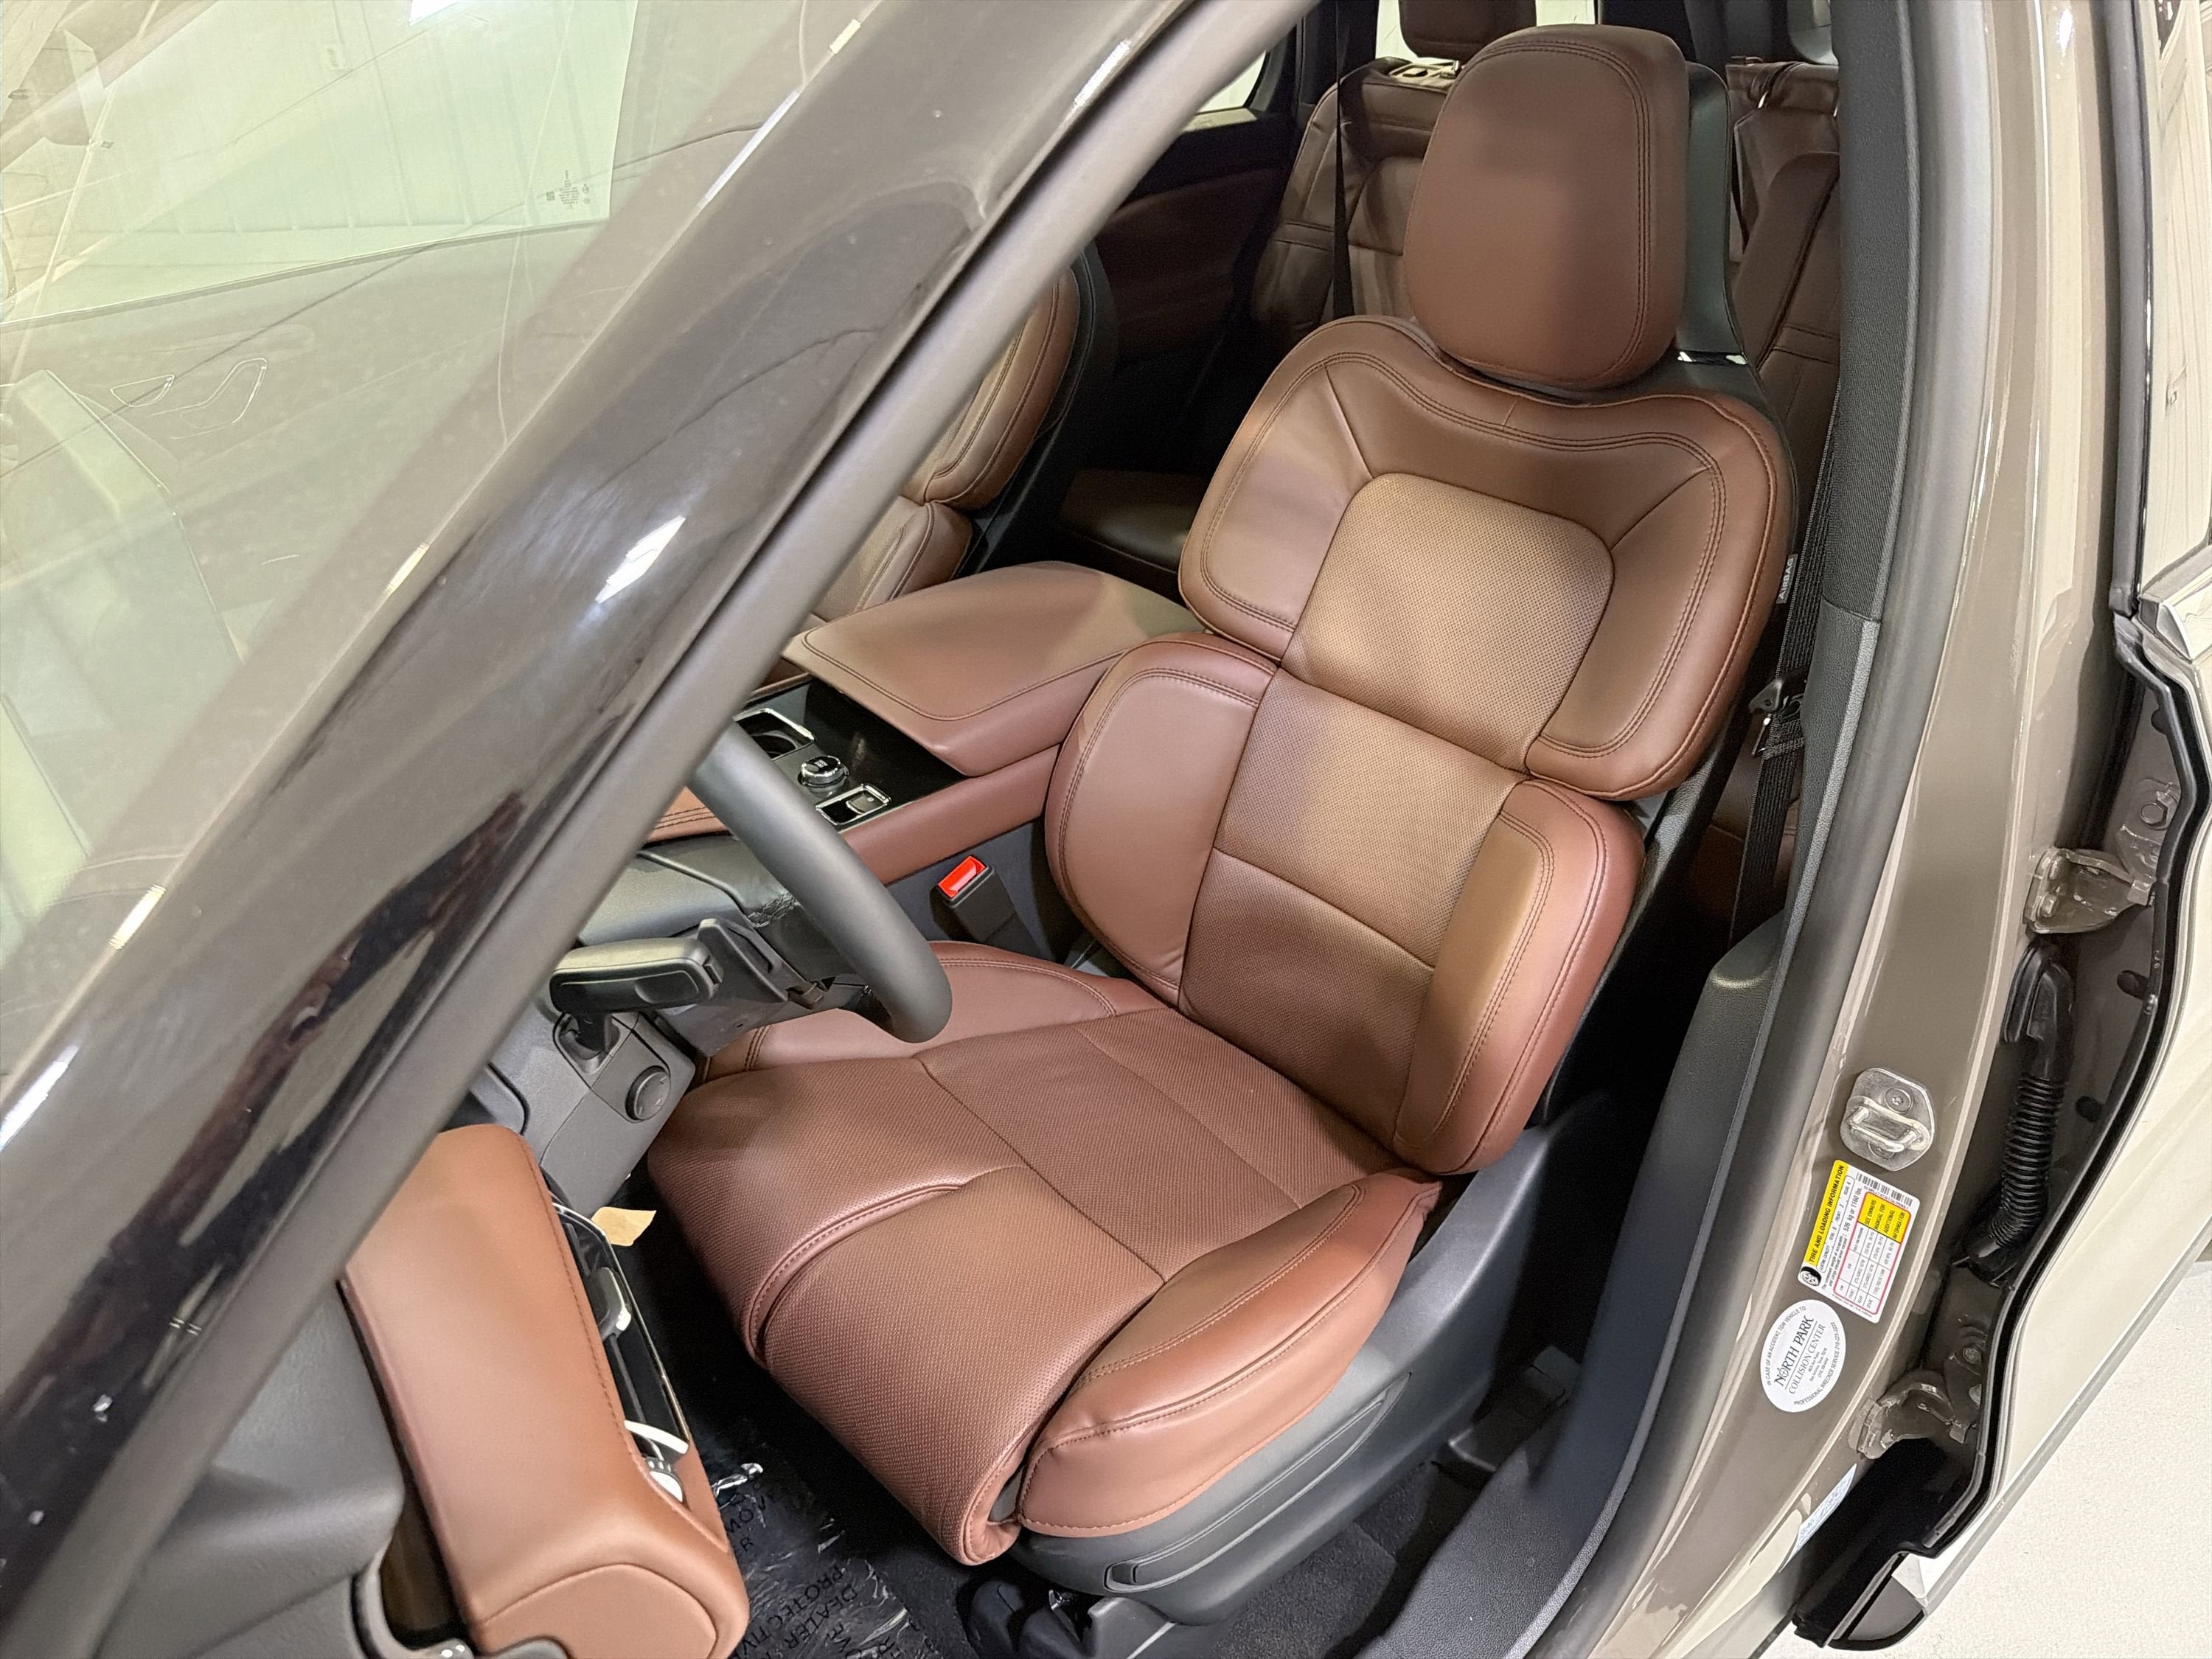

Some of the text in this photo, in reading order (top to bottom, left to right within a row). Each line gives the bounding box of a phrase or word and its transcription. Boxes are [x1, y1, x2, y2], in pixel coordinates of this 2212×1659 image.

[1778, 557, 1794, 599] AIRBAG
[1808, 1164, 1846, 1263] TIRE AND LOADING INFORMATION
[1846, 1214, 1854, 1222] kg
[1850, 1194, 1860, 1208] 1160
[1843, 1221, 1851, 1232] 526
[1783, 1308, 1801, 1322] VEHICLE
[1773, 1313, 1815, 1387] NORTH PARK
[1787, 1322, 1826, 1395] COLLISION CENTER
[1792, 1386, 1823, 1405] PROFESSIONAL
[1819, 1368, 1834, 1388] WRECKER
[1831, 1349, 1840, 1368] SERVICE
